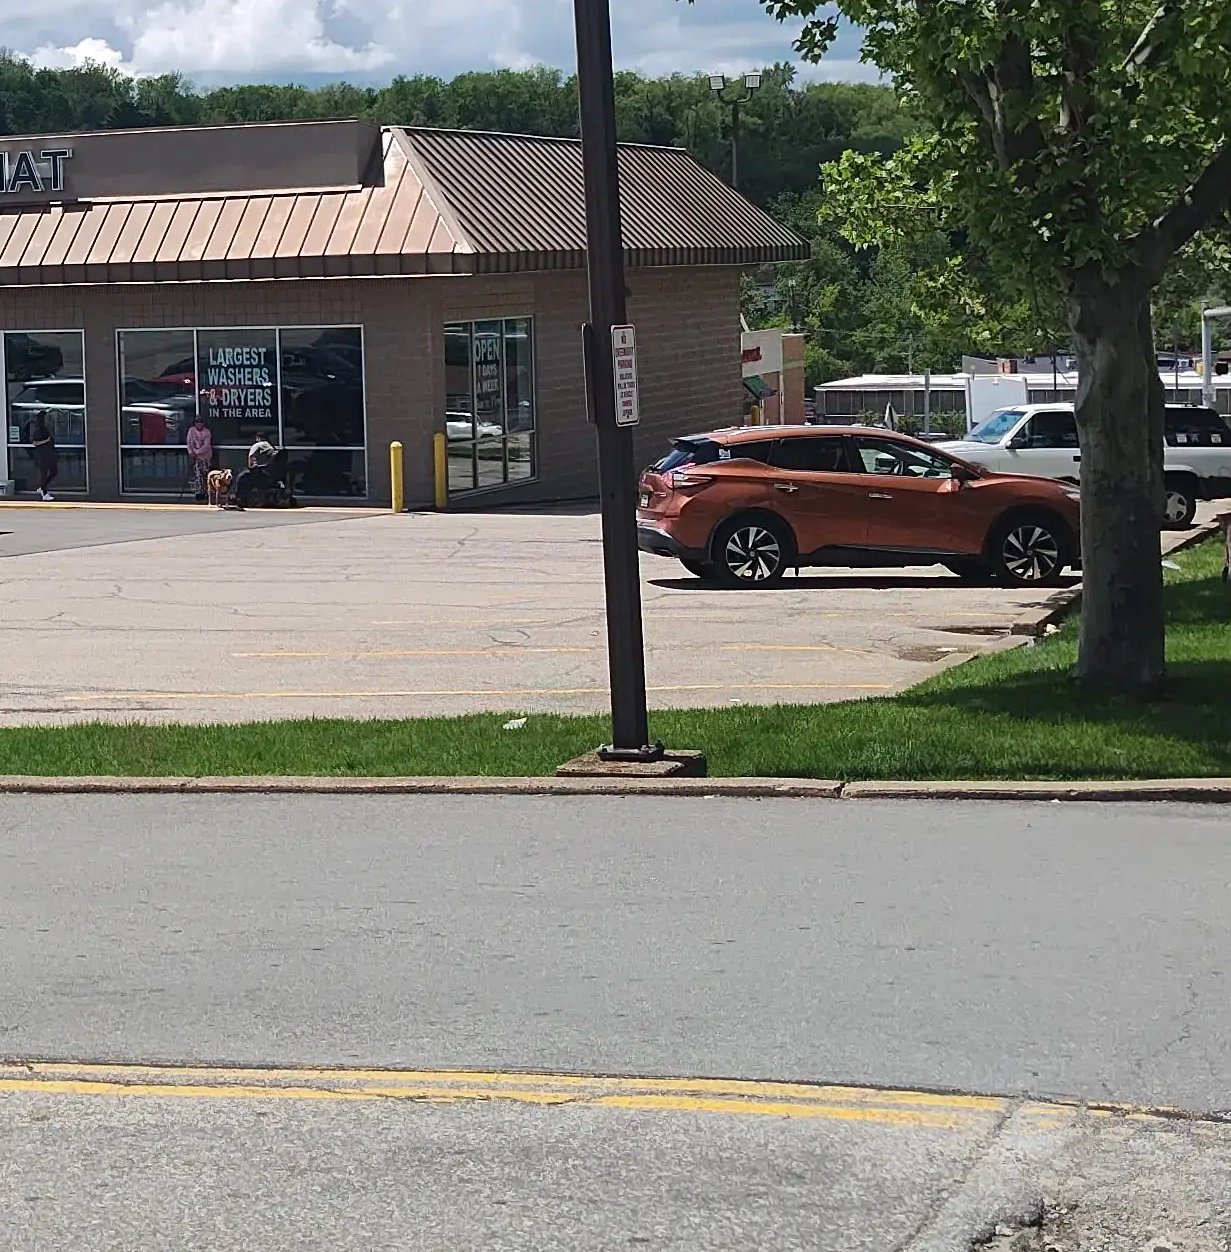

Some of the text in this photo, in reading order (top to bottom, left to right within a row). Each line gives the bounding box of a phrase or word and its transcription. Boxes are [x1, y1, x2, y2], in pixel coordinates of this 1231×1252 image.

[210, 347, 267, 366] LARGEST
[475, 339, 500, 362] OPEN
[208, 367, 269, 386] WASHERS
[210, 388, 272, 406] & DRYERS
[210, 408, 272, 418] IN THE AREA
